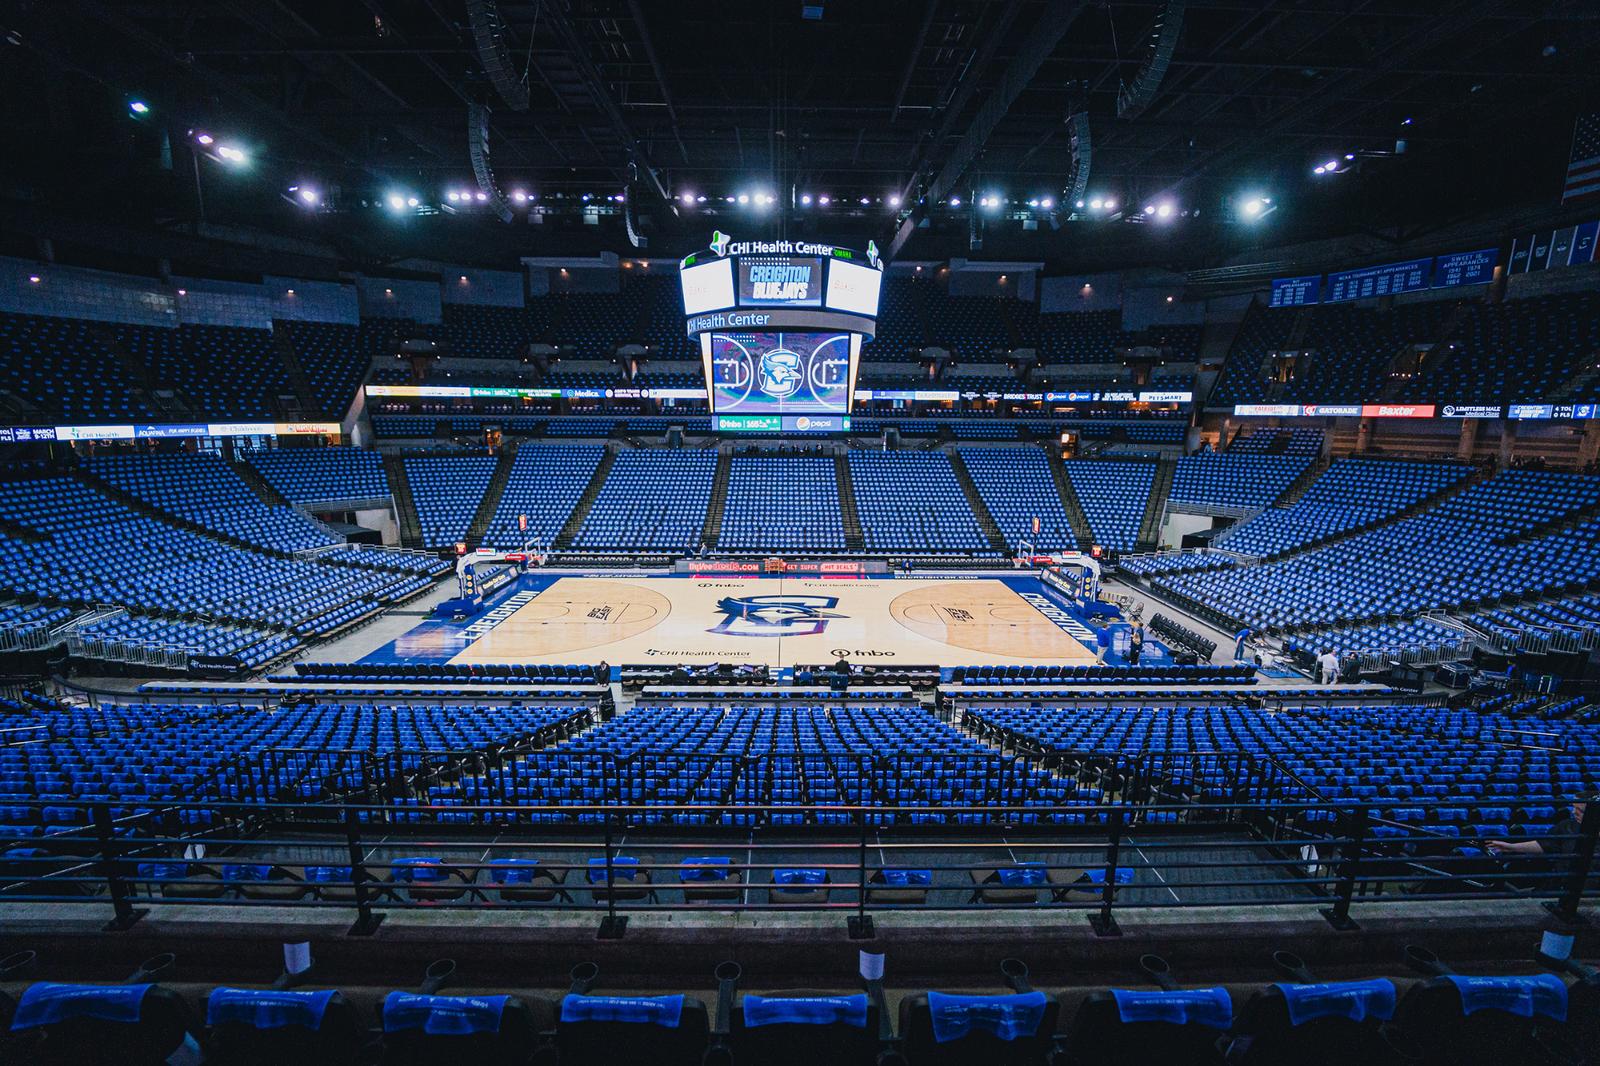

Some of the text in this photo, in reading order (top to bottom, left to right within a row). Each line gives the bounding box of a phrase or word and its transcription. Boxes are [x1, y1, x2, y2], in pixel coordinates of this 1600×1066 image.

[730, 240, 833, 256] CHI Health Center
[1443, 258, 1488, 268] APPEARANCES
[750, 266, 811, 282] CREIGHTON
[752, 282, 808, 299] BLUEJAYS
[697, 314, 725, 329] Health
[728, 314, 769, 325] Center
[1379, 406, 1415, 415] Baxter
[811, 420, 831, 429] pepsi
[456, 590, 540, 640] CREIGHTON
[1019, 593, 1098, 640] CREIGHTON
